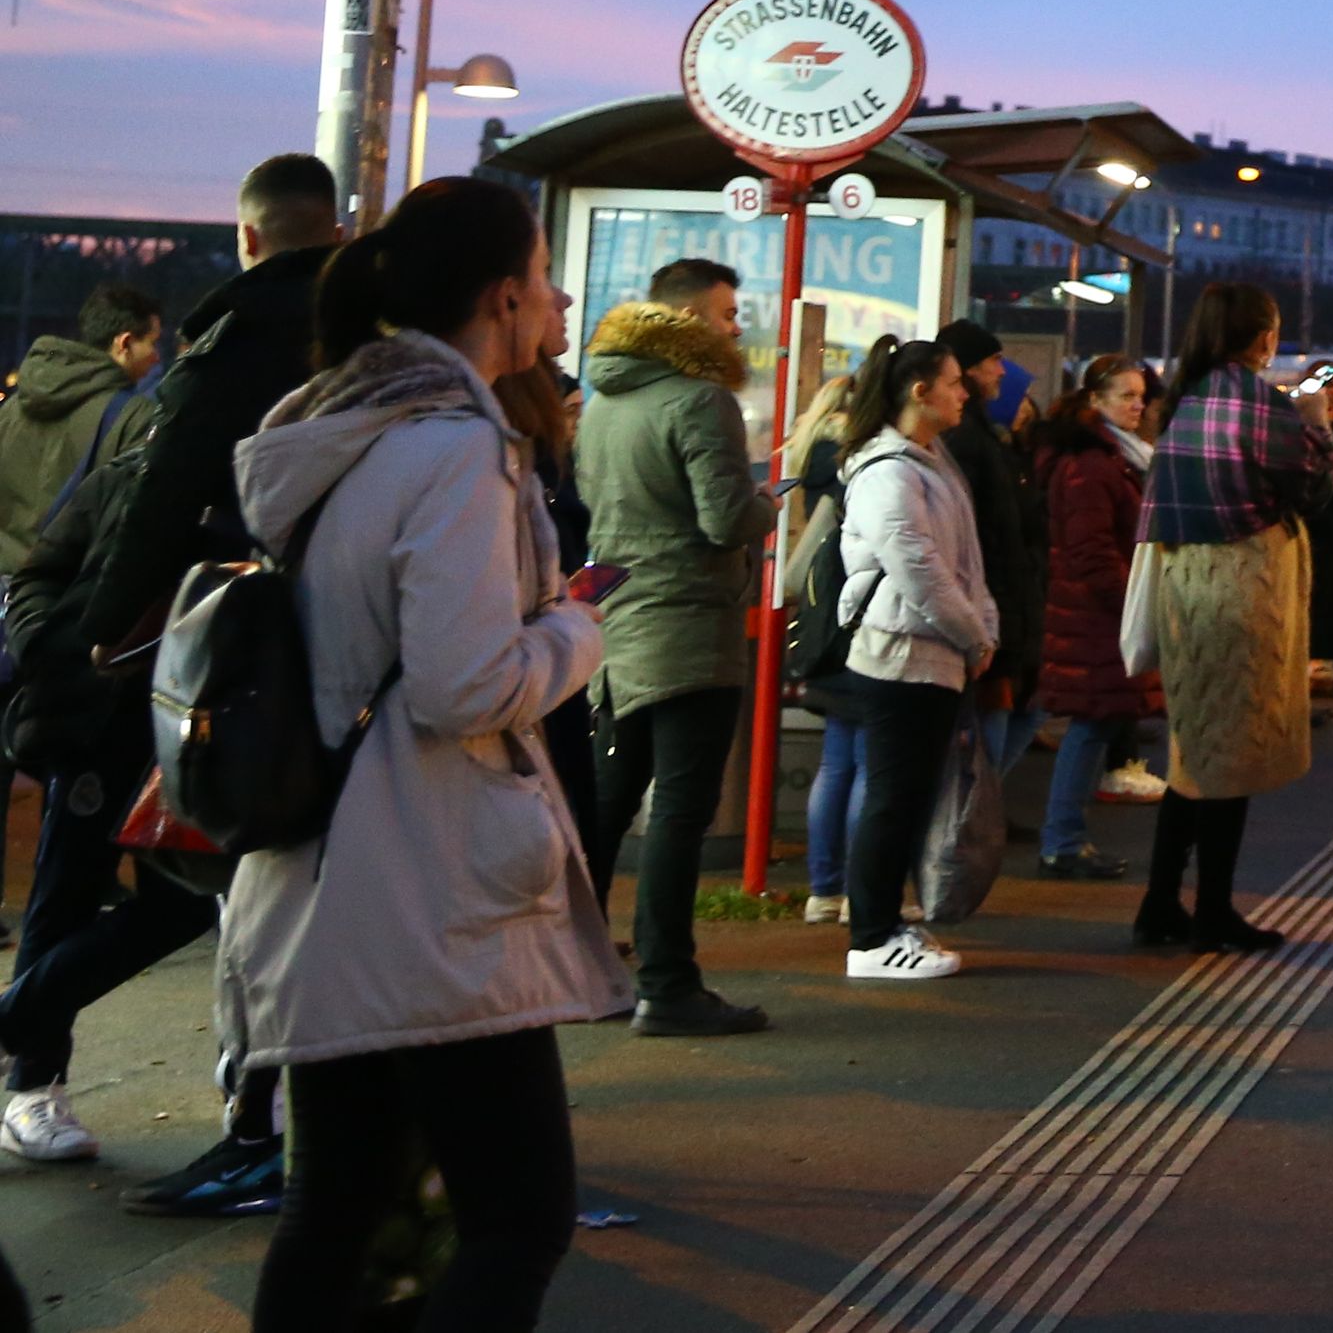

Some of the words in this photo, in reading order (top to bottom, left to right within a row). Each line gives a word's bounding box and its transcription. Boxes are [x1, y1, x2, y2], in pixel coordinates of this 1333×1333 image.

[716, 82, 887, 138] HALTESTELLE
[729, 187, 760, 212] 18
[842, 185, 861, 210] 6
